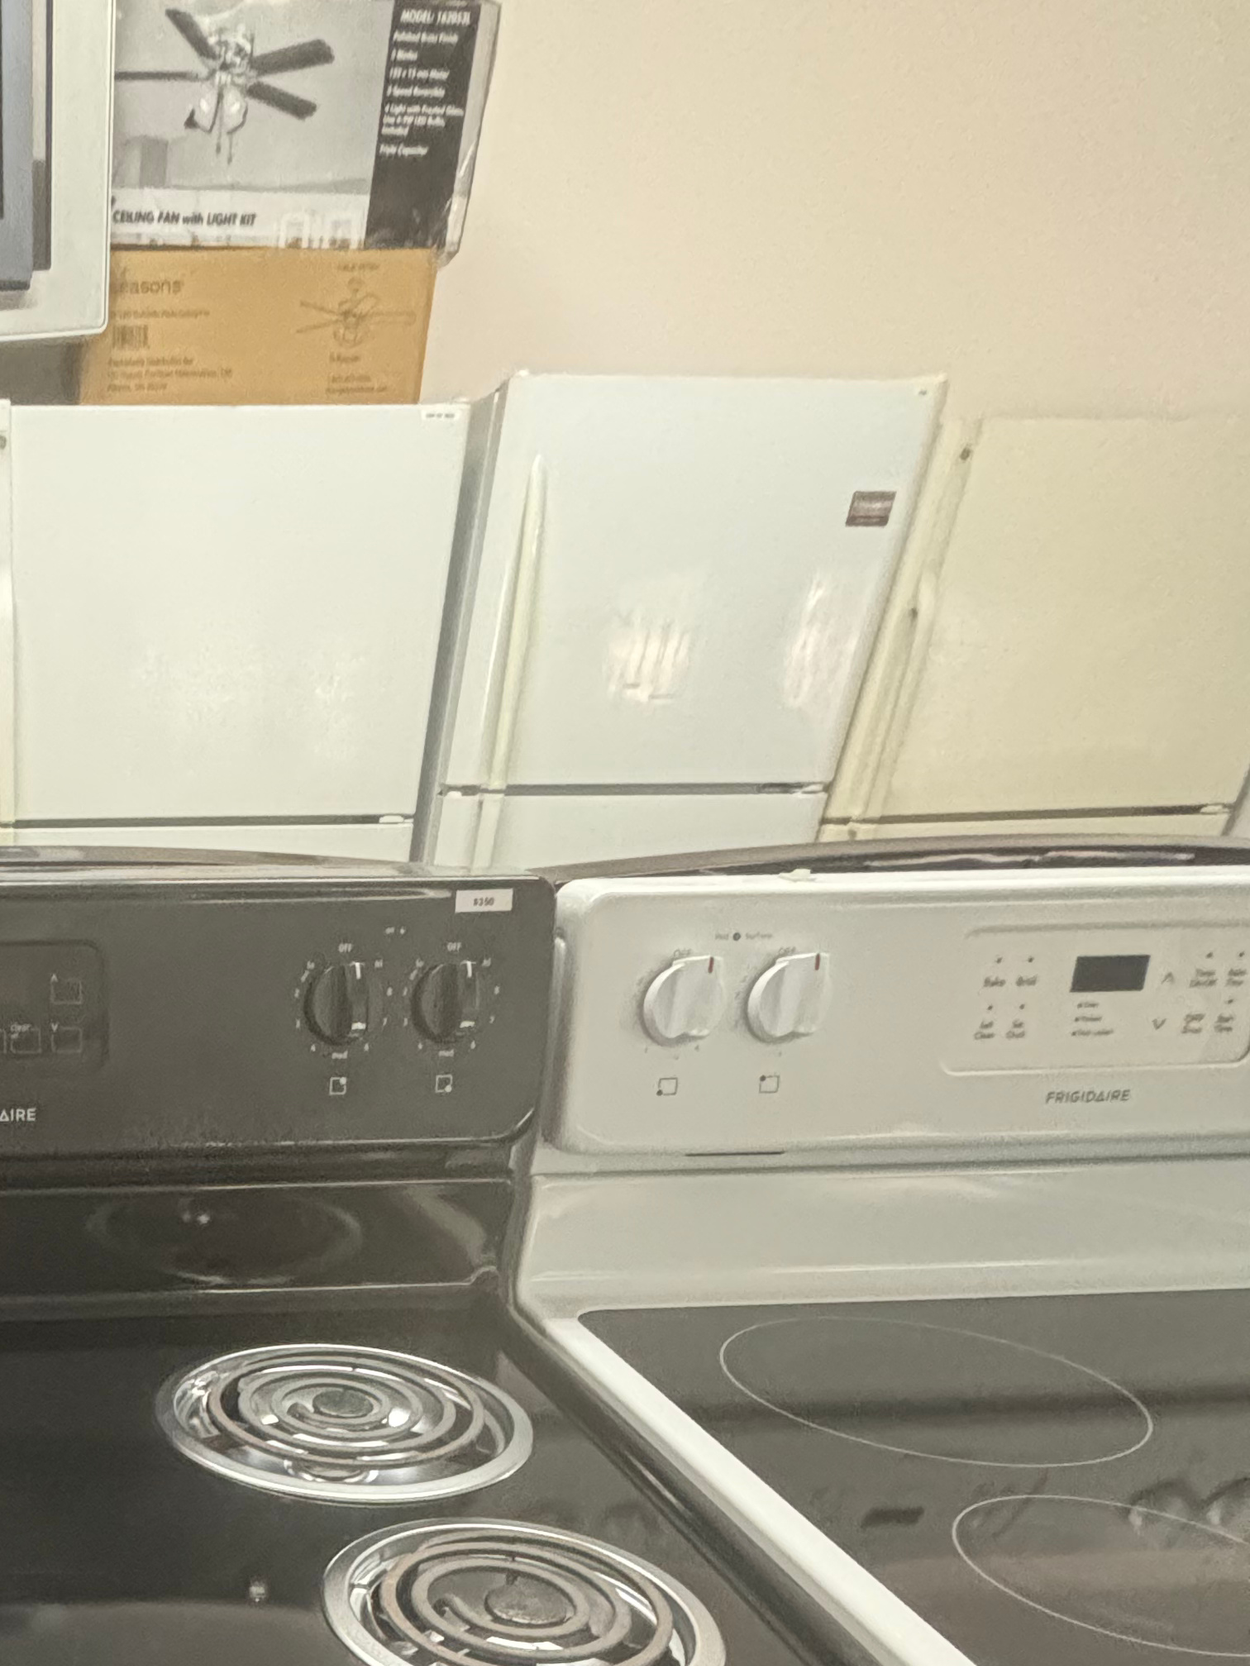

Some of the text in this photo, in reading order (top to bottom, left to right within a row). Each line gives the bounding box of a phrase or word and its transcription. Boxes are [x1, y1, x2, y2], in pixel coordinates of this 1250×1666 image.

[112, 210, 257, 226] CEILING FAN with LIGHT KIT
[338, 943, 353, 953] OFF
[447, 942, 462, 952] OFF
[1045, 1089, 1131, 1104] FRIGIDAIRE
